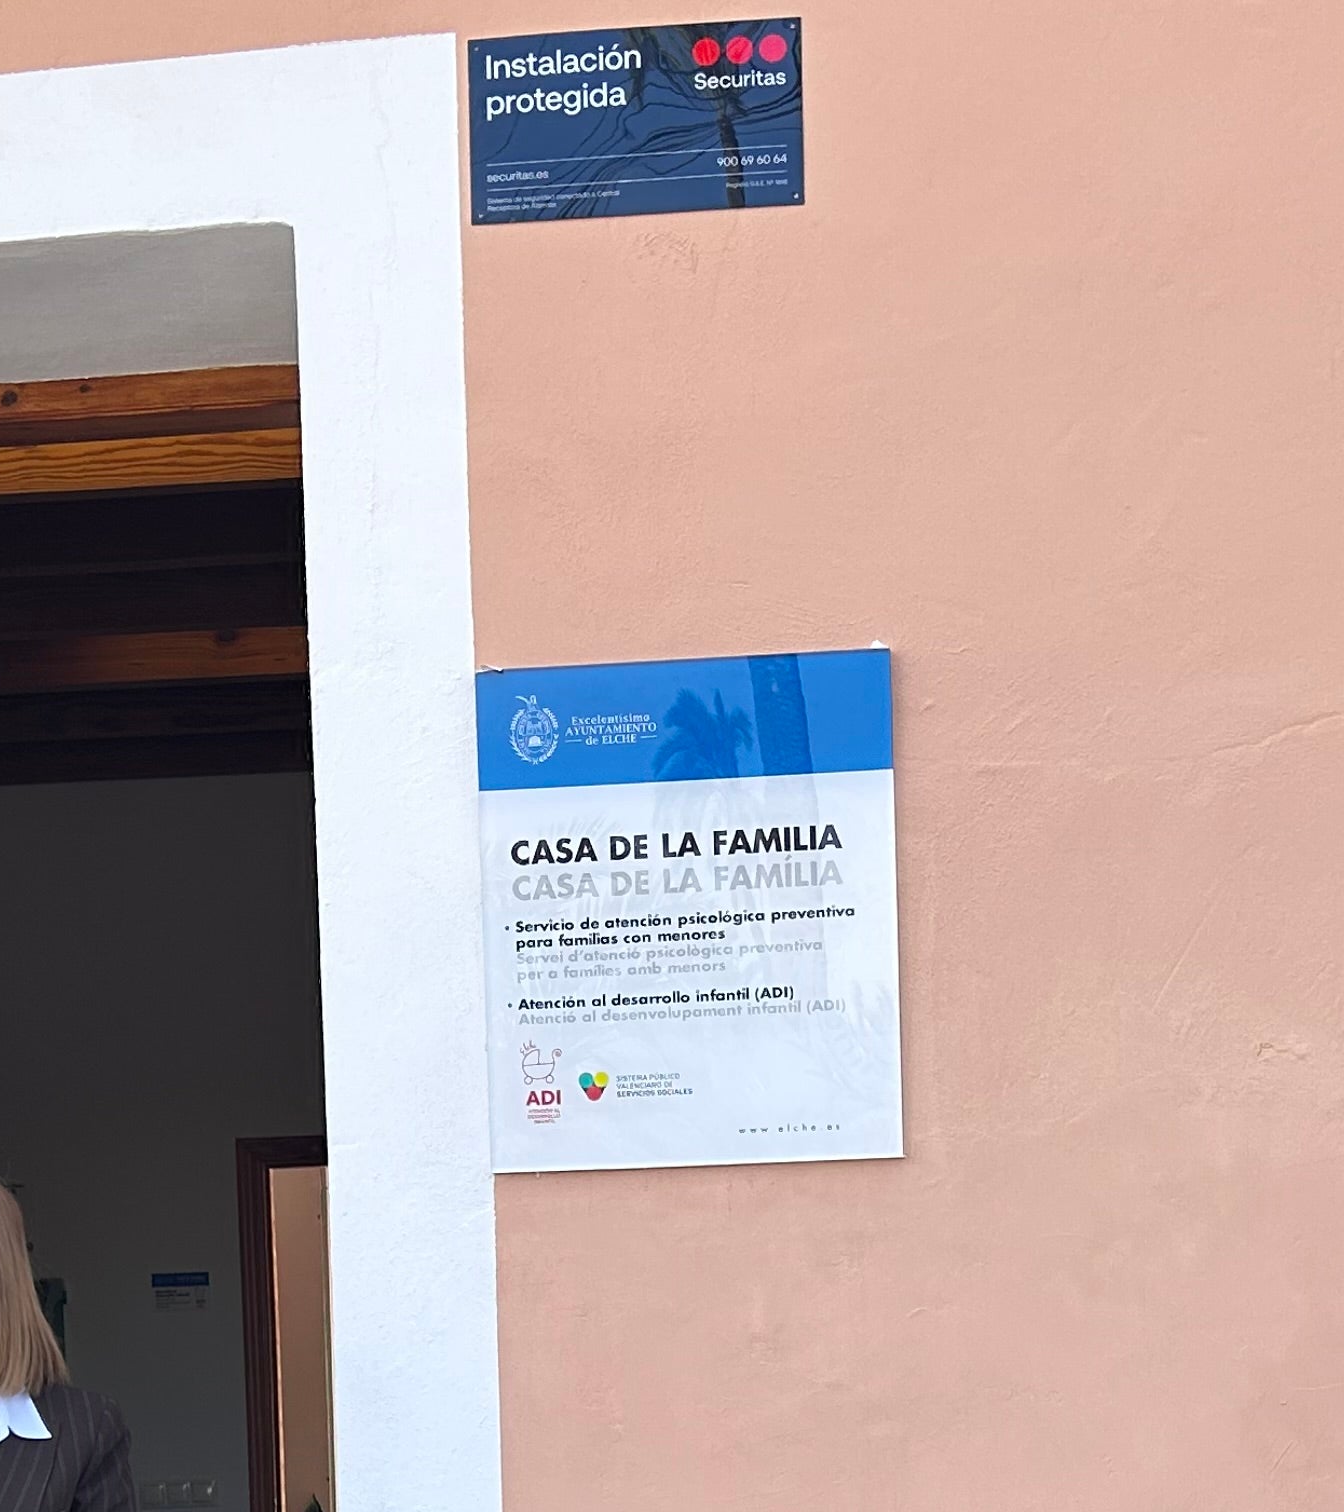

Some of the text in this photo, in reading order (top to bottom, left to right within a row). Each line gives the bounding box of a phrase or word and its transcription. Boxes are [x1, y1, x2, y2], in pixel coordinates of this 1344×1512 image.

[485, 44, 642, 81] Instalación
[694, 69, 787, 90] Securitas
[486, 82, 627, 121] protegida
[717, 153, 787, 167] 900 69 60 64
[486, 170, 549, 183] securitas.es
[565, 722, 657, 737] AYUNTAMIENTO
[585, 733, 637, 746] de ELCHE
[510, 824, 843, 866] CASA DE LA FAMILIA
[511, 854, 844, 901] CASA DE LA FAMÍLIA
[515, 905, 855, 934] Servicio de atención psicológica preventiva
[516, 929, 726, 952] para familias con menores
[739, 939, 823, 957] preventiva
[517, 970, 544, 984] per
[548, 970, 558, 980] a
[627, 962, 662, 976] amb
[667, 961, 726, 975] menors
[518, 985, 794, 1011] Atención al desarrollo infantil (ADI)
[518, 998, 846, 1026] Atenció al desenvolupament infantil (ADI)
[526, 1089, 562, 1106] ADI
[657, 1088, 693, 1096] SOCIALES
[738, 1123, 840, 1134] wwwelche.es
